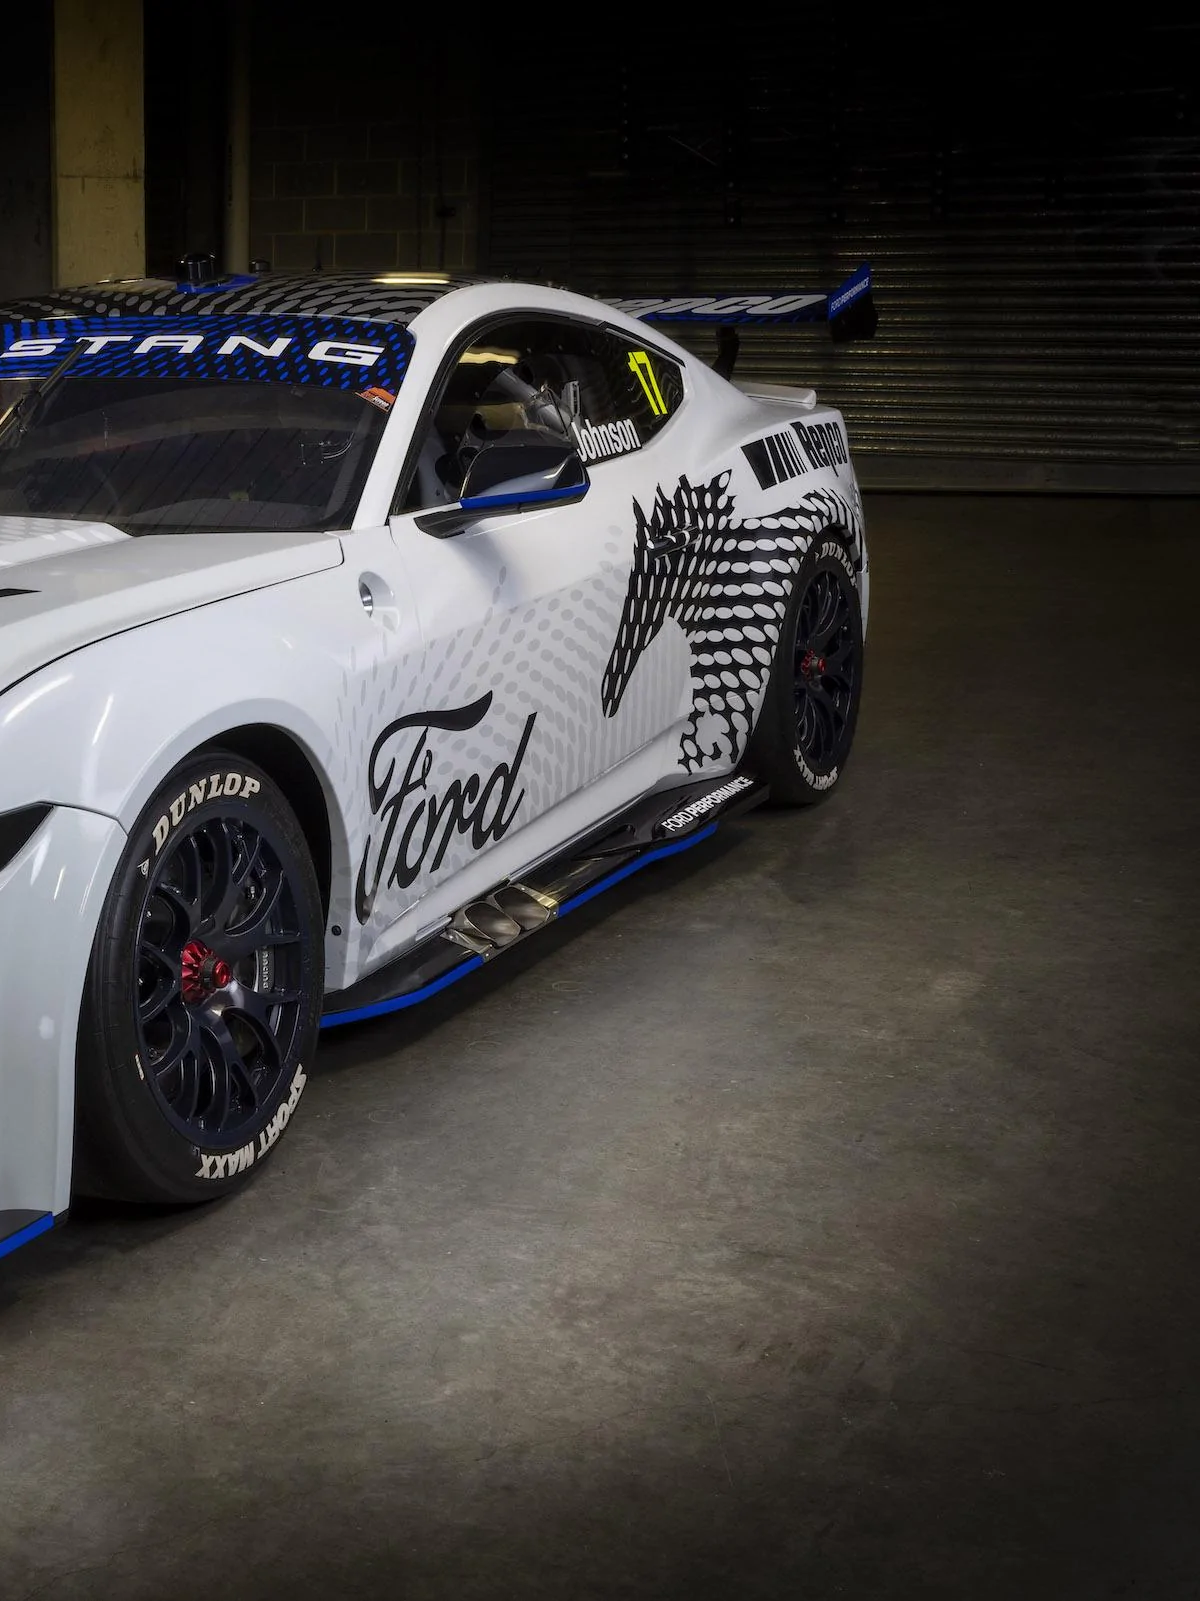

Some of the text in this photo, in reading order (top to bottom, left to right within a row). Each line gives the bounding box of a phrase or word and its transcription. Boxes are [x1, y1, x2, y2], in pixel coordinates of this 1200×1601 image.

[627, 351, 668, 415] 17
[571, 418, 642, 462] Johnson
[790, 421, 848, 477] Repco
[152, 772, 261, 857] DUNLOP
[355, 690, 538, 926] Ford
[661, 776, 755, 832] FORD PERFORMANCE
[194, 1063, 307, 1179] SPORT MAXX
